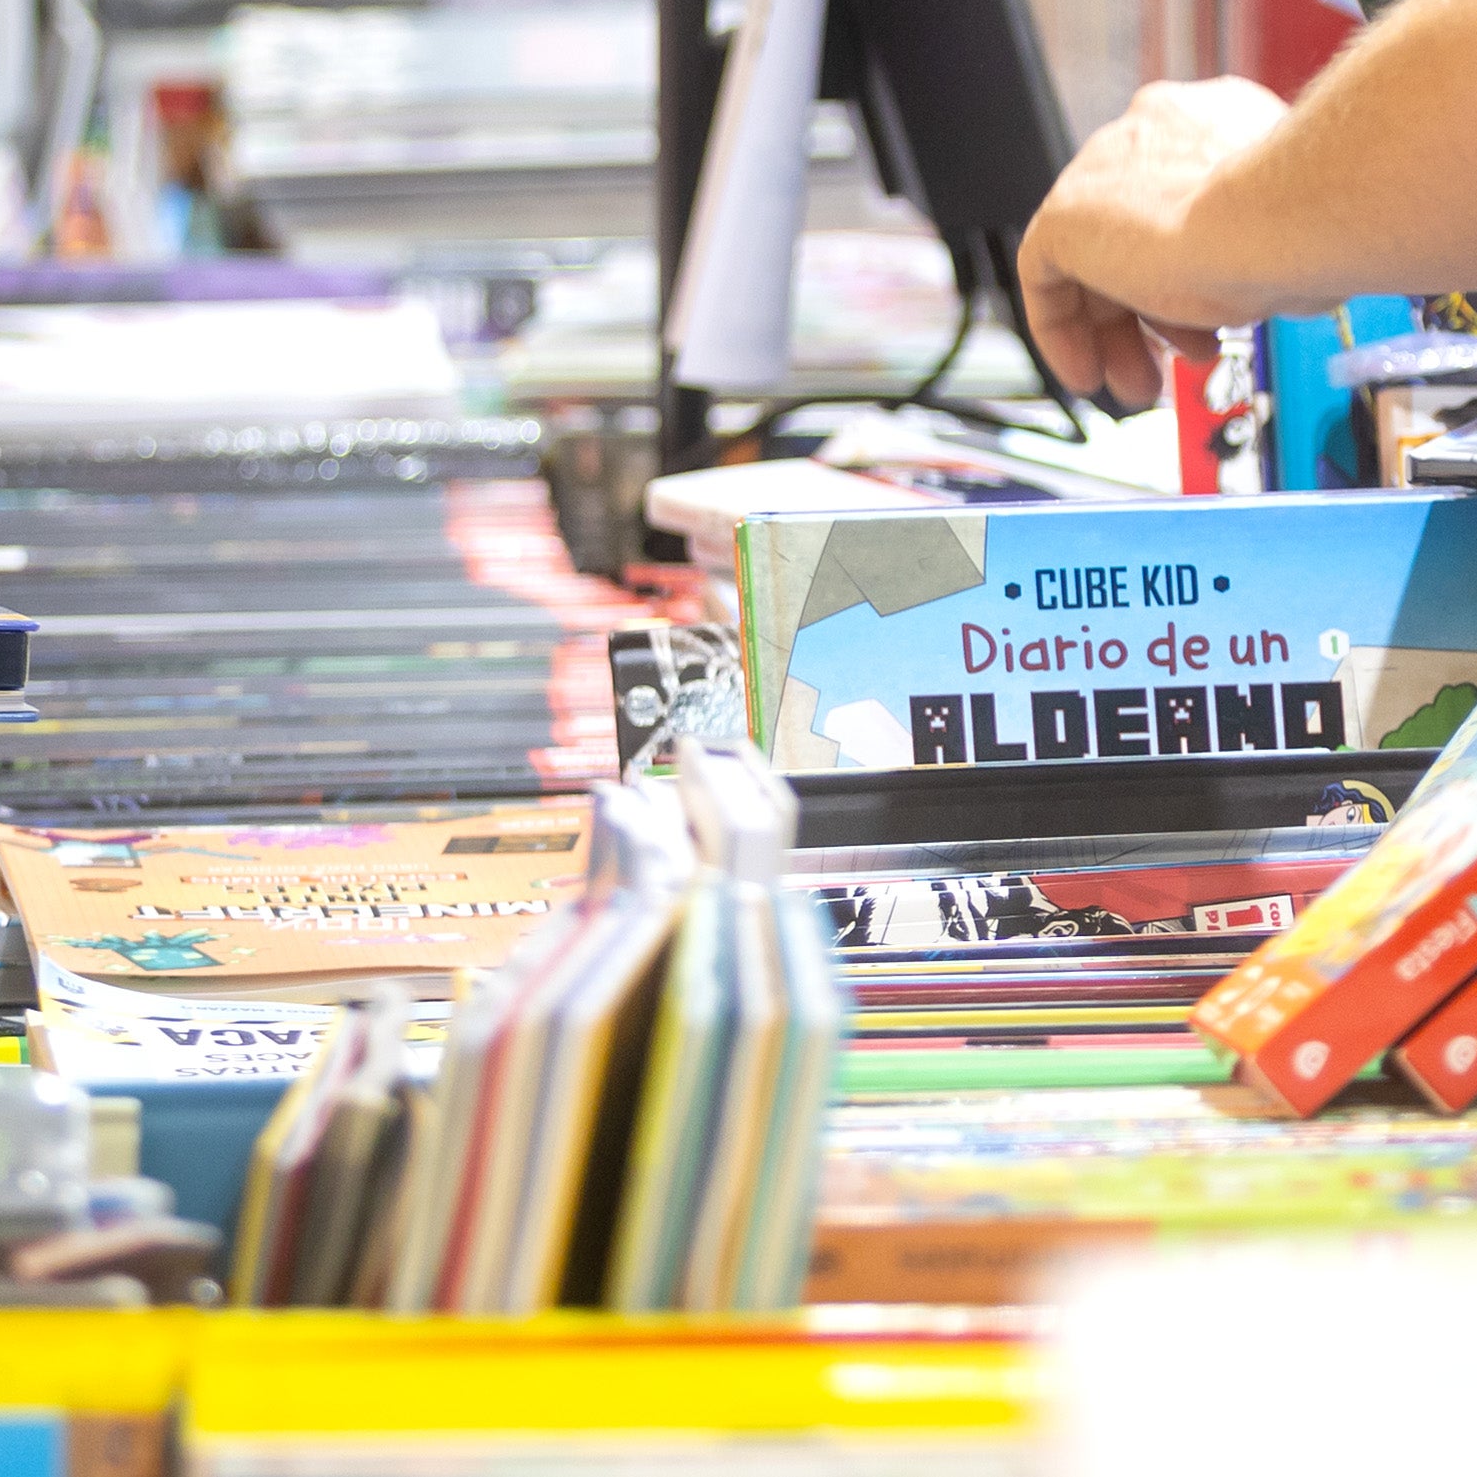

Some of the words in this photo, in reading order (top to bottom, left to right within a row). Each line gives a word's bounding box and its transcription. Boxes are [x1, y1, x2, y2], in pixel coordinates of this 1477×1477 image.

[1032, 565, 1130, 611] CUBE
[1140, 563, 1200, 608] KID
[959, 622, 1130, 676] Diario
[1145, 621, 1214, 673] de
[1228, 628, 1291, 666] un
[909, 680, 1346, 765] ALDEANO
[128, 900, 550, 921] MINECRAFT
[203, 1051, 315, 1063] ACES
